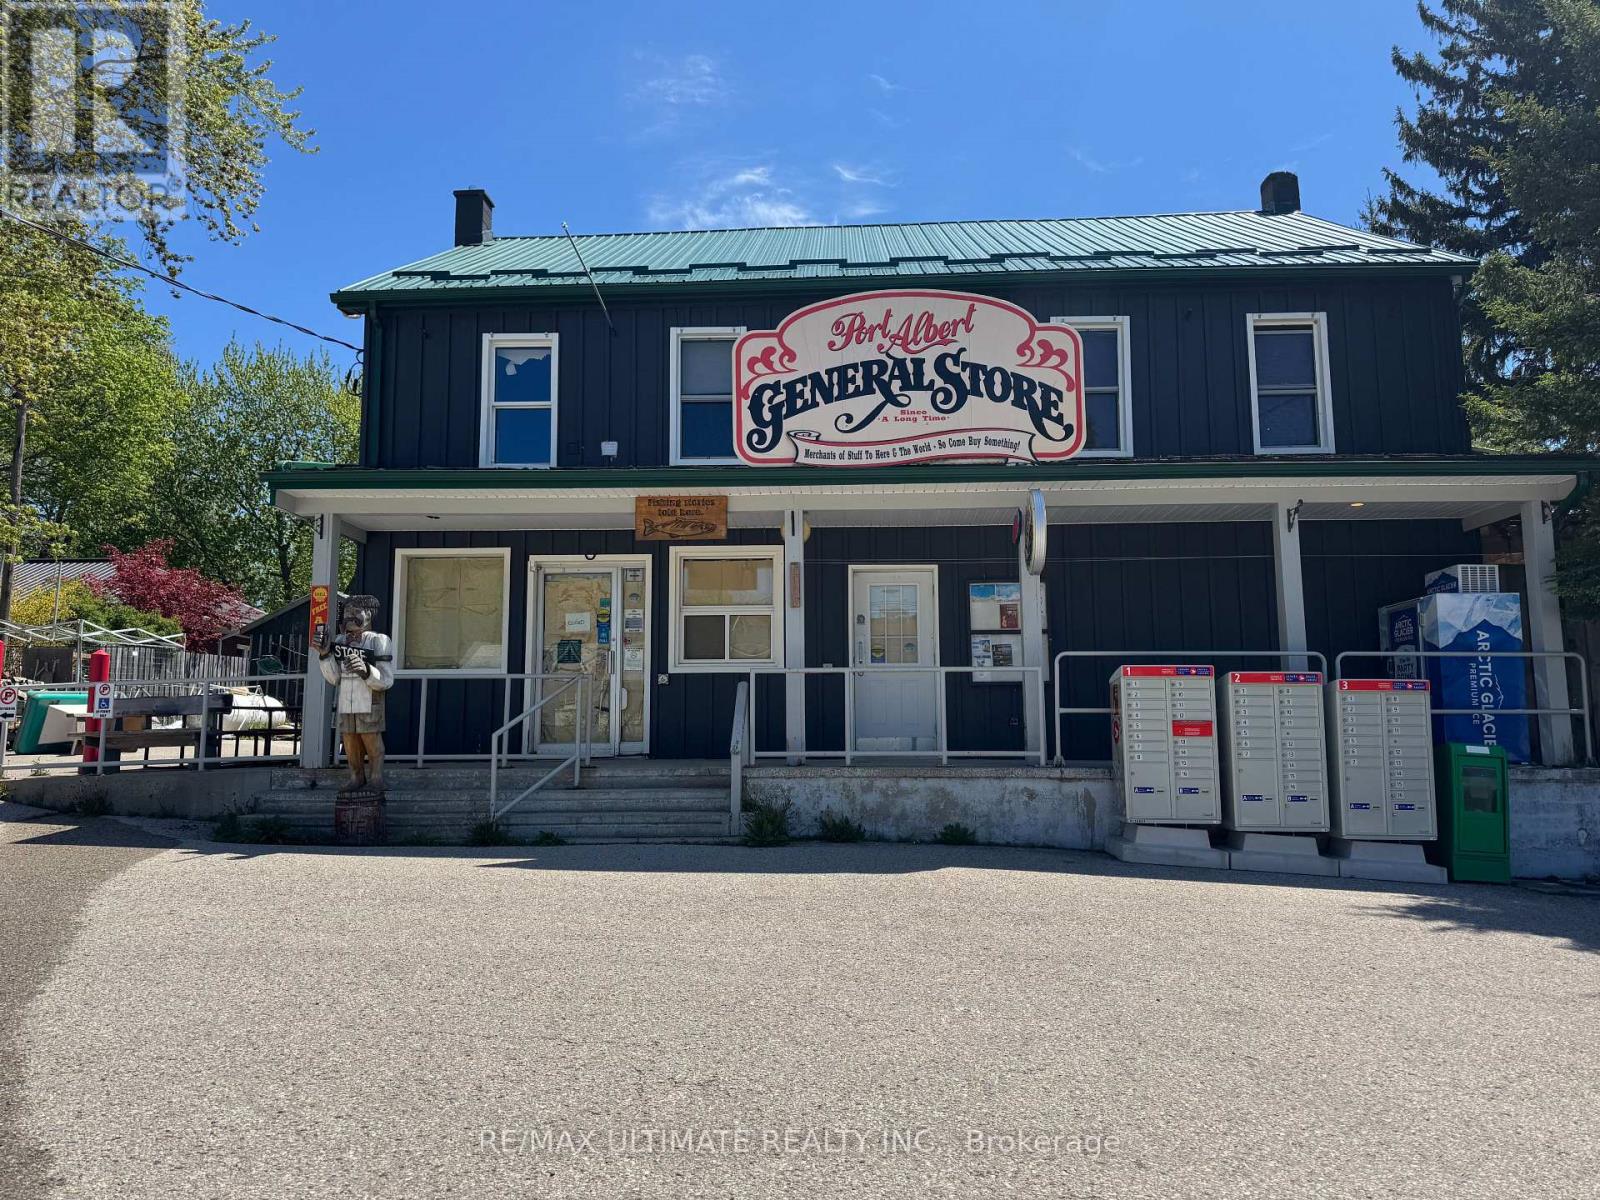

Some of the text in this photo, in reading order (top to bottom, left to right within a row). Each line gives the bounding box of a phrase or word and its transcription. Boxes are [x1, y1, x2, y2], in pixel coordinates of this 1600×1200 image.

[828, 303, 976, 354] Port Albert
[746, 347, 1074, 453] GENERAL STORE
[804, 448, 836, 460] Merchants
[848, 450, 862, 460] Stuff
[865, 450, 872, 459] To
[875, 449, 890, 459] Here
[899, 446, 911, 456] The
[912, 442, 932, 454] World
[938, 439, 946, 449] So
[948, 438, 966, 448] Come
[968, 436, 982, 448] Buy
[984, 436, 1020, 453] Something!
[1126, 667, 1130, 676] 1
[1234, 673, 1240, 682] 2
[1342, 681, 1348, 690] 3
[1468, 662, 1479, 706] PREMIUM
[1480, 692, 1497, 746] GLACIE
